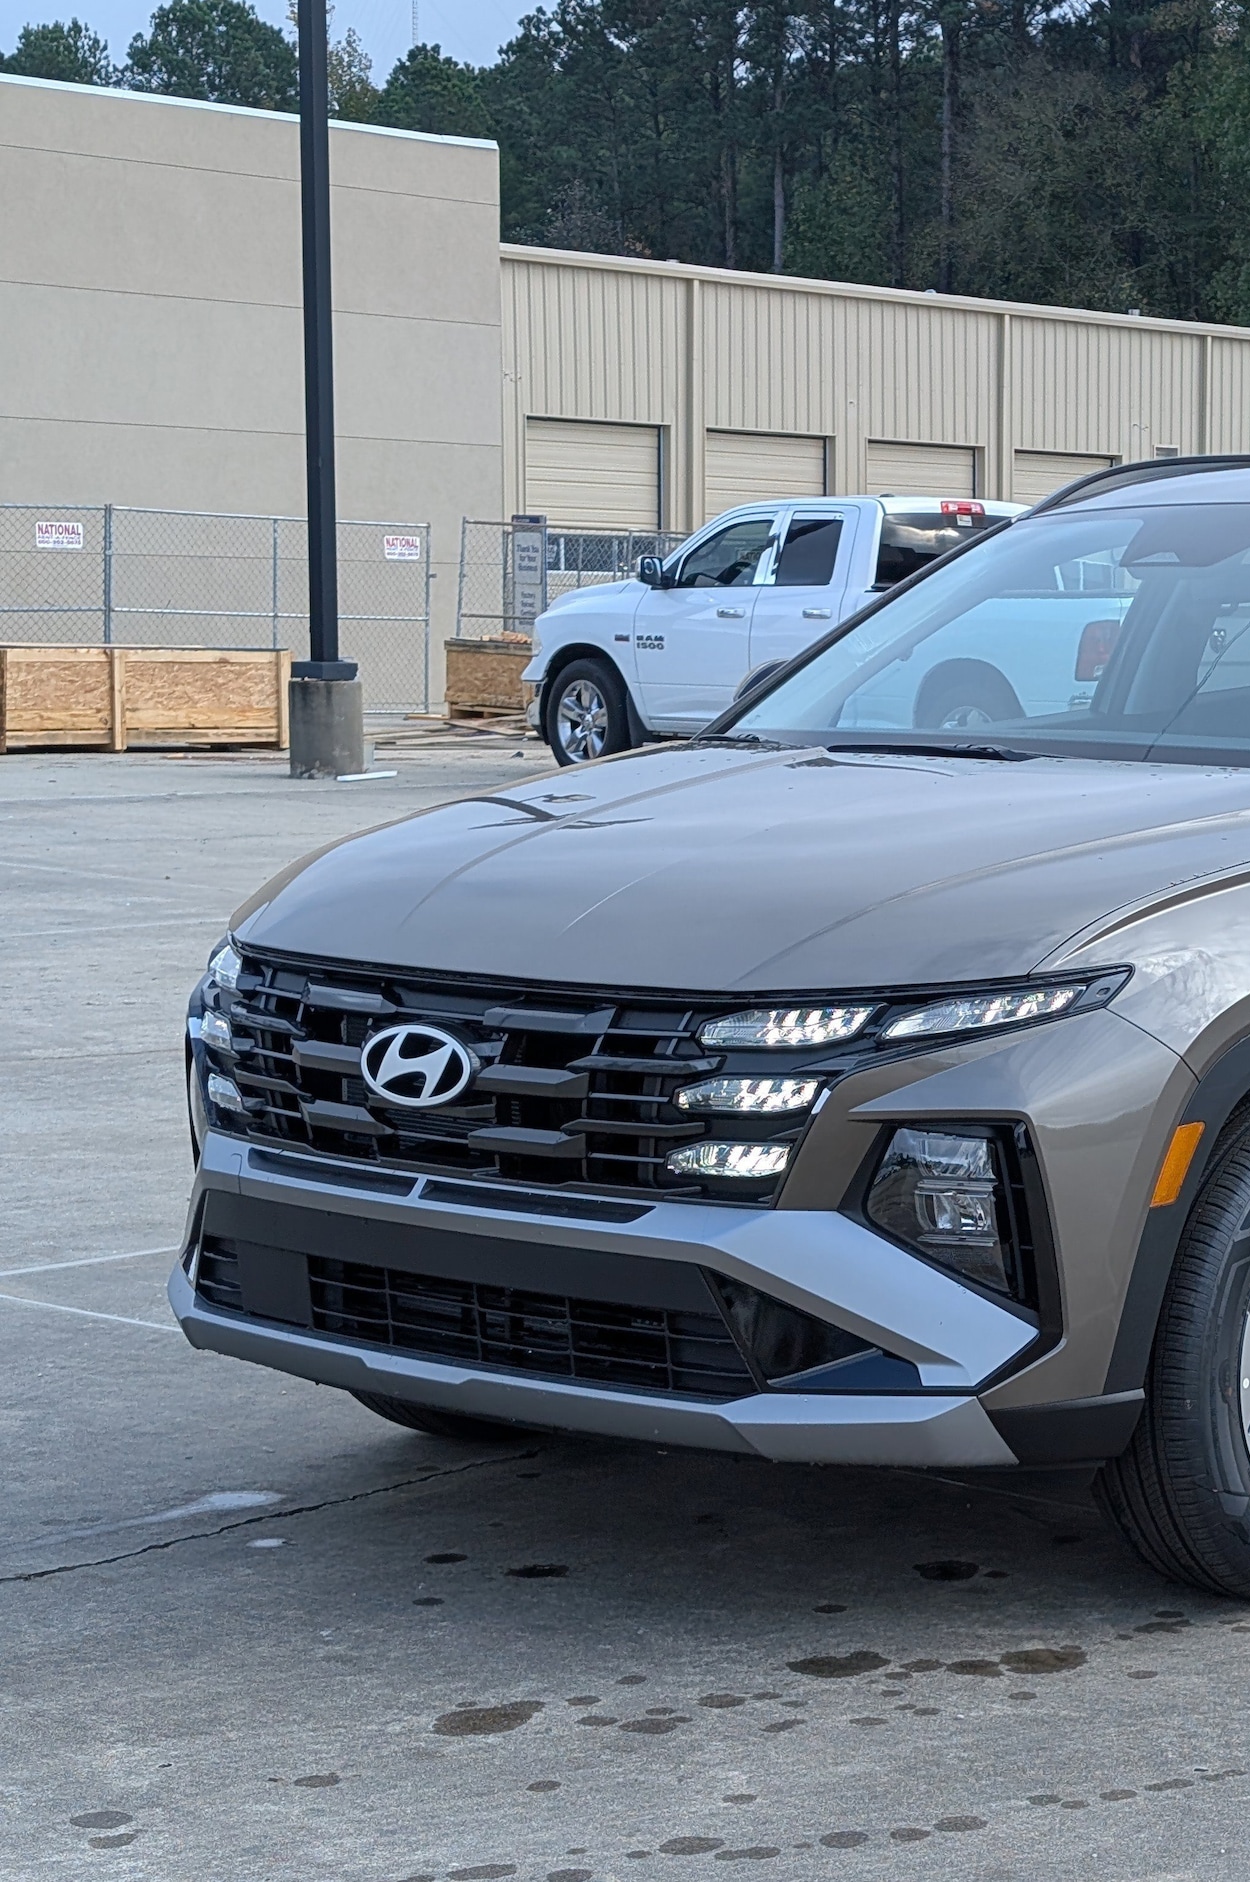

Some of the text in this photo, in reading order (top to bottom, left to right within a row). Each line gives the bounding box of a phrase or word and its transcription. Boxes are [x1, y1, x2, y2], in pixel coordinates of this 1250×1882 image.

[38, 524, 81, 535] NATIONAL
[386, 537, 418, 548] NATIONAL
[636, 642, 665, 650] 1500
